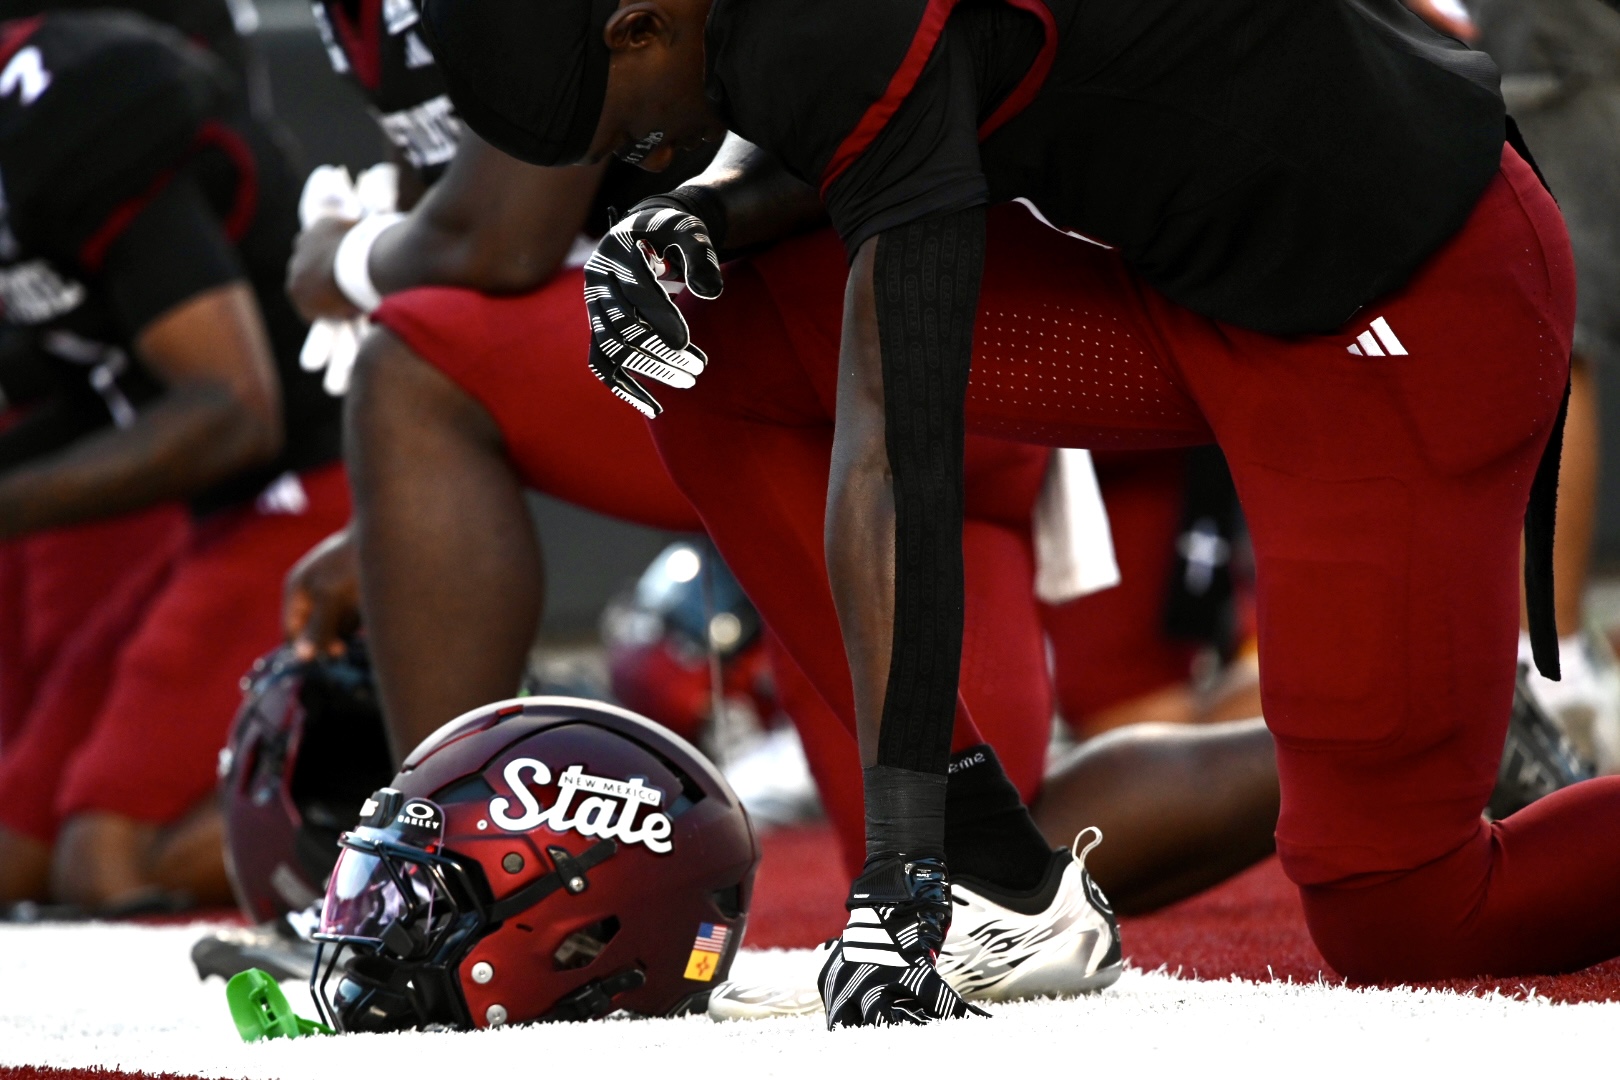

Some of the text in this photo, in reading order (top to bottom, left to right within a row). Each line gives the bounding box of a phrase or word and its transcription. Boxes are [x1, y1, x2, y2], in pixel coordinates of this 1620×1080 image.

[563, 775, 657, 802] NEW MEXICO
[489, 757, 673, 854] State
[397, 814, 440, 830] OAKLEY
